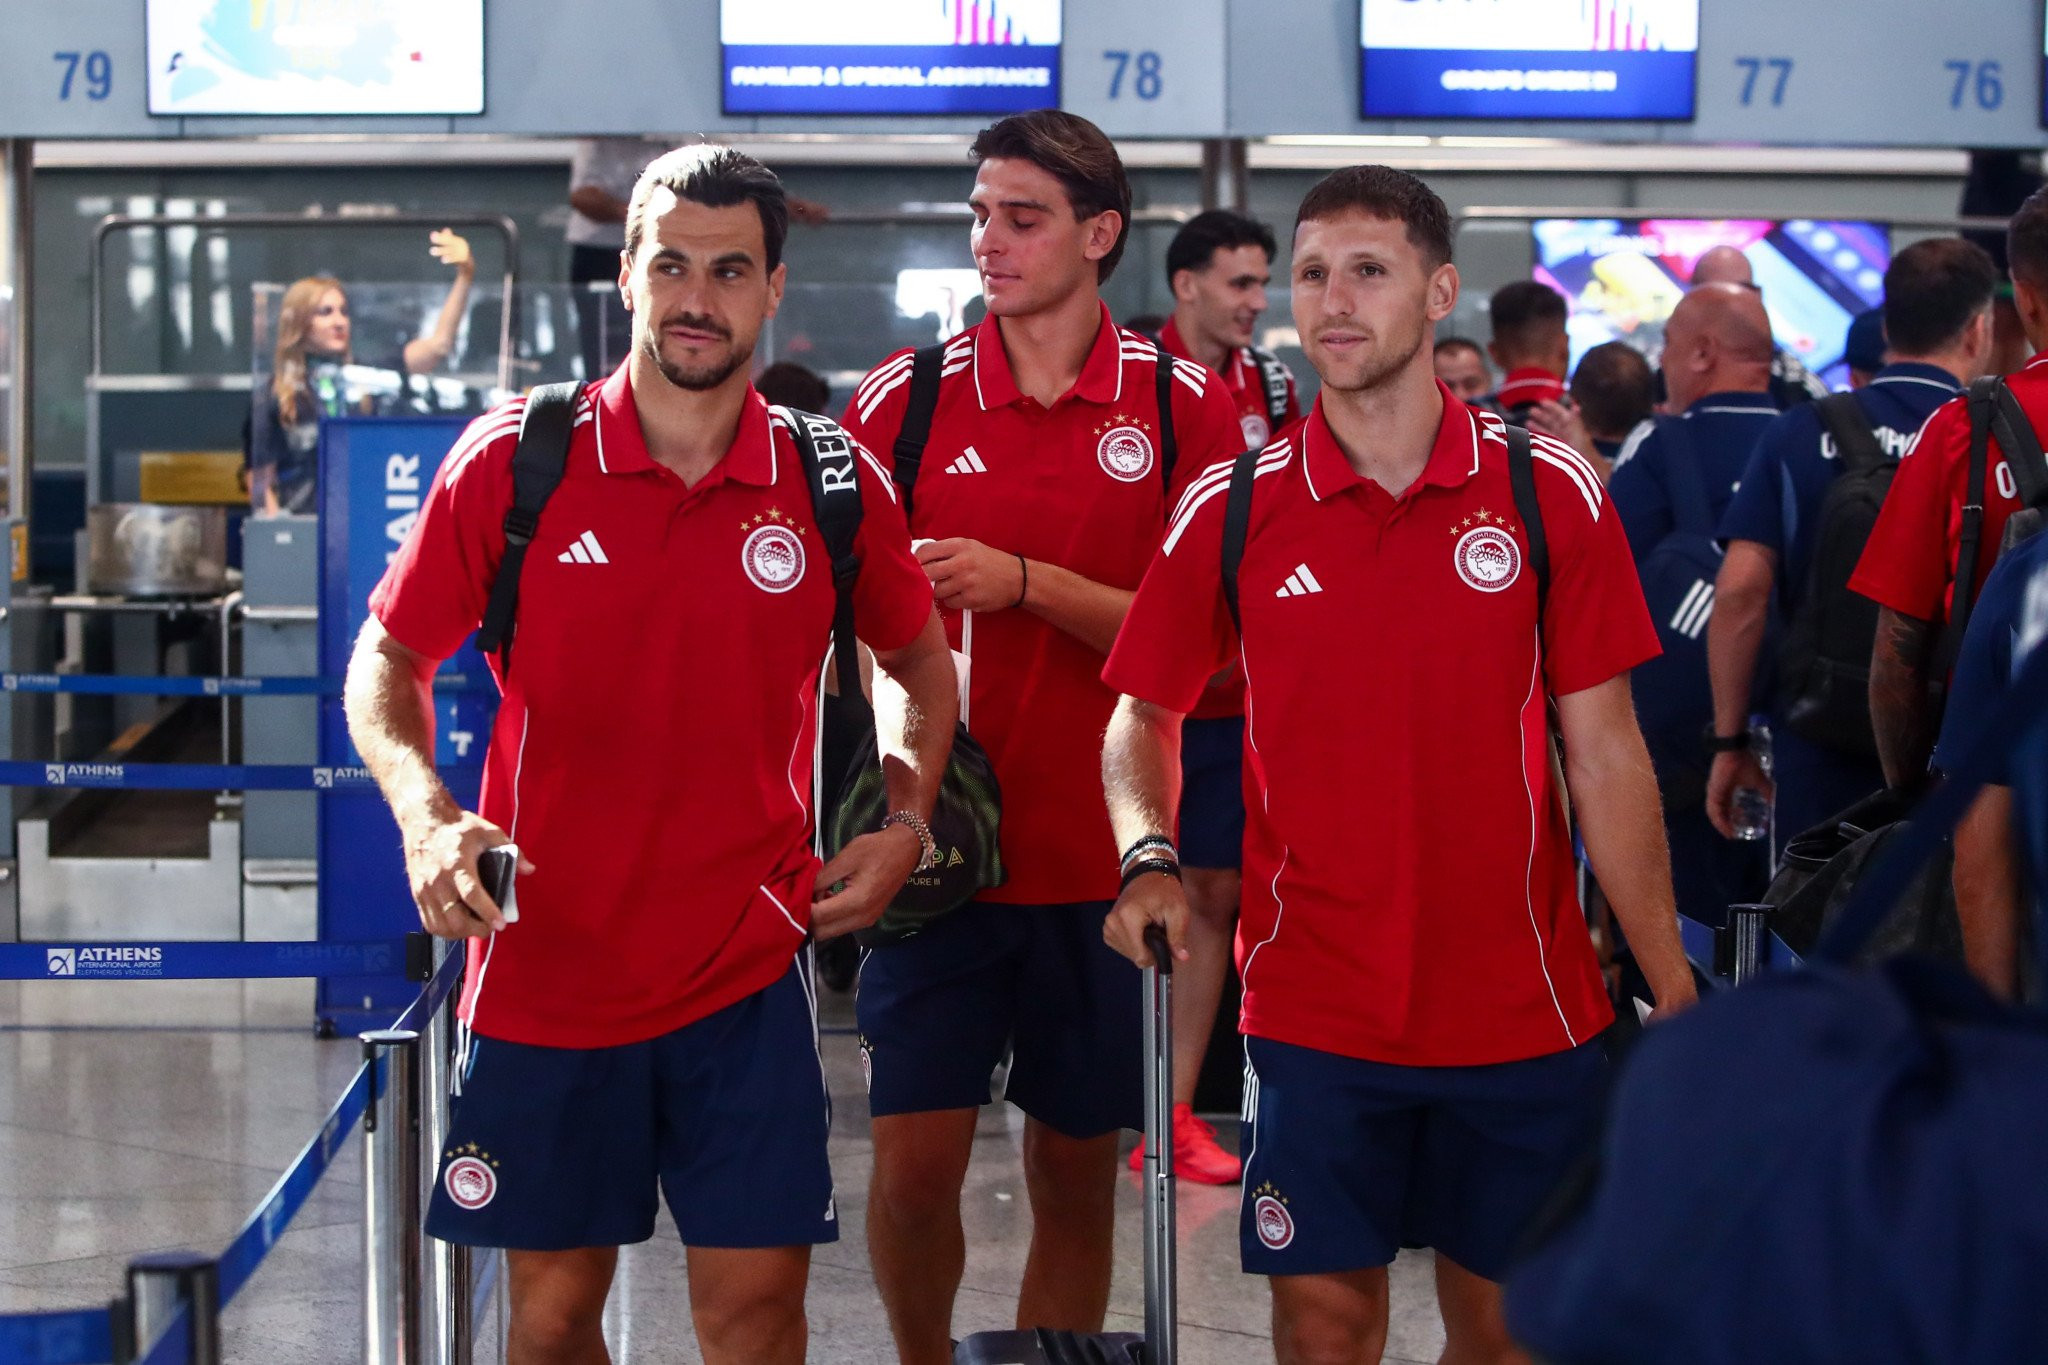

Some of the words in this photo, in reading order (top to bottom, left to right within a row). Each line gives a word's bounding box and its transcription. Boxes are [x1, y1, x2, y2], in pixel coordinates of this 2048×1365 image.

[54, 51, 112, 100] 79
[731, 66, 823, 86] FAMILIES
[841, 66, 926, 86] SPECIAL
[927, 67, 1051, 86] ASSISTANCE
[1103, 51, 1162, 100] 78
[1735, 56, 1794, 106] 77
[1944, 59, 2004, 111] 76
[67, 764, 124, 776] ATHENS
[906, 877, 932, 886] PURE
[78, 947, 162, 961] ATHENS
[77, 961, 131, 969] INTERNATIONAL
[77, 968, 122, 976] ELEFTHERIOS
[125, 968, 163, 976] VENIZELOS
